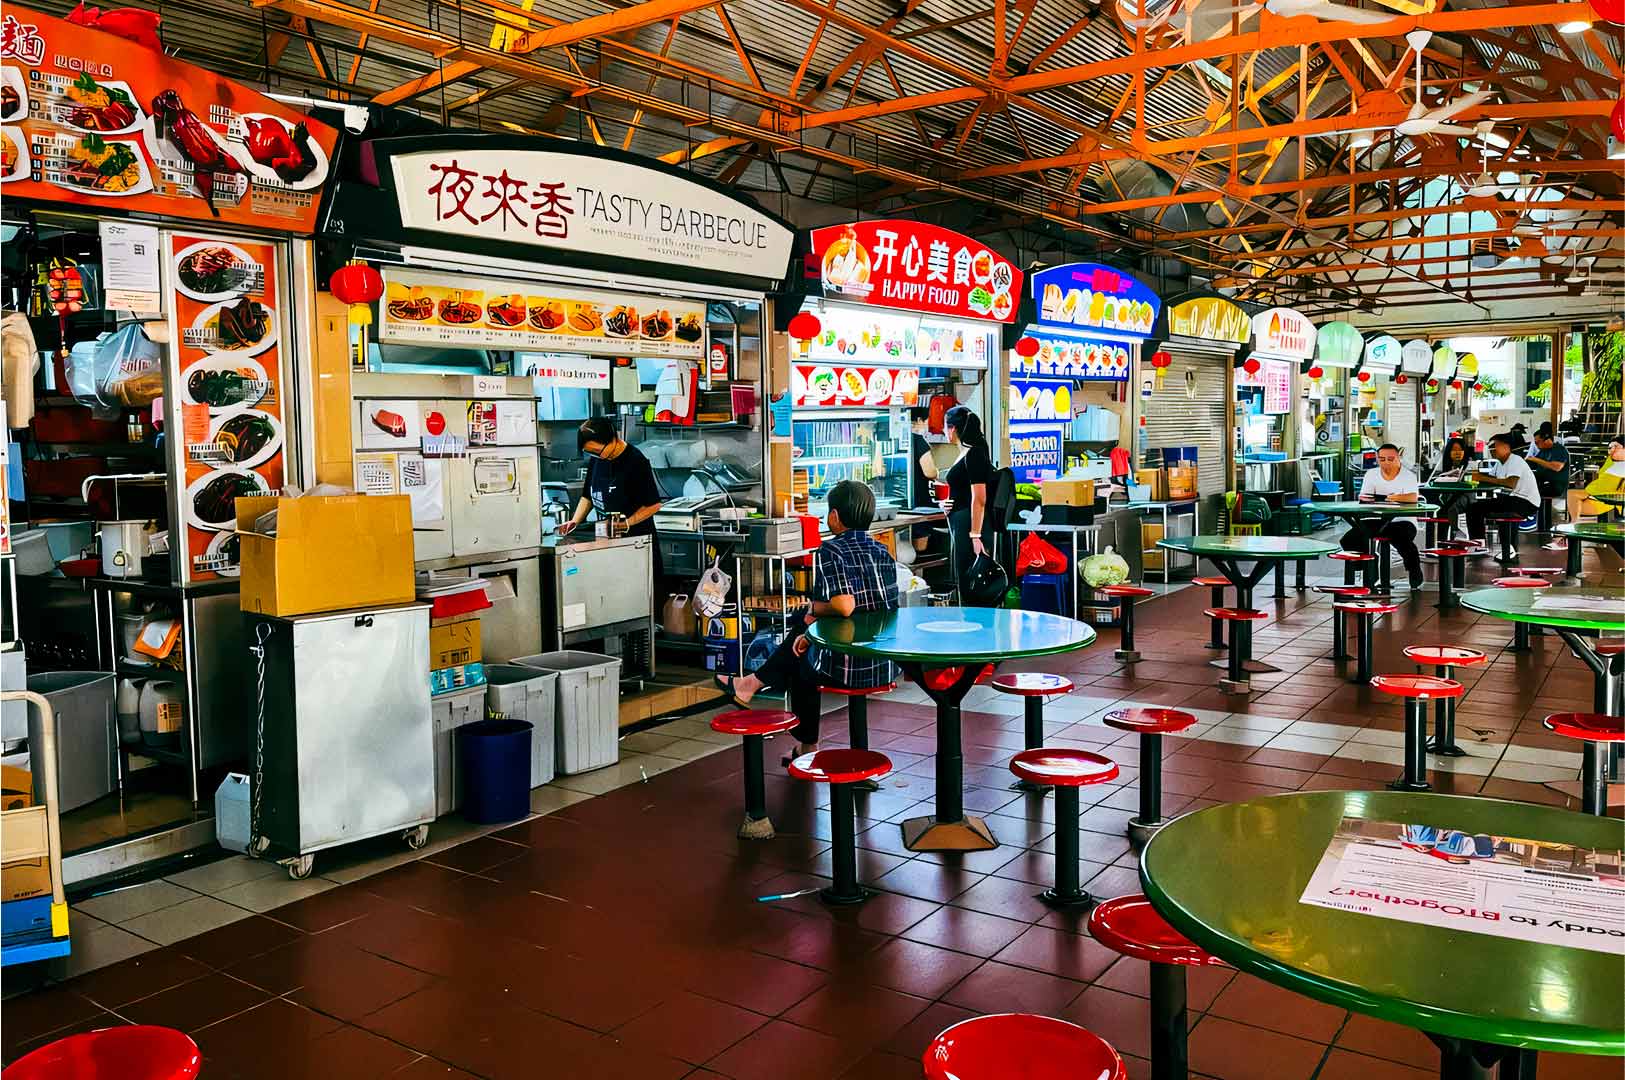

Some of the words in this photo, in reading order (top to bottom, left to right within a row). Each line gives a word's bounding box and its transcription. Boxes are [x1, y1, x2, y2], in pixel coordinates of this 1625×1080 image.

[428, 159, 574, 239] 夜來香
[576, 187, 653, 229] TASTY
[660, 204, 767, 249] BARBECUE
[872, 229, 973, 287] 开心美食
[882, 278, 926, 302] HAPPY
[928, 286, 959, 307] FOOD
[1509, 914, 1537, 927] to
